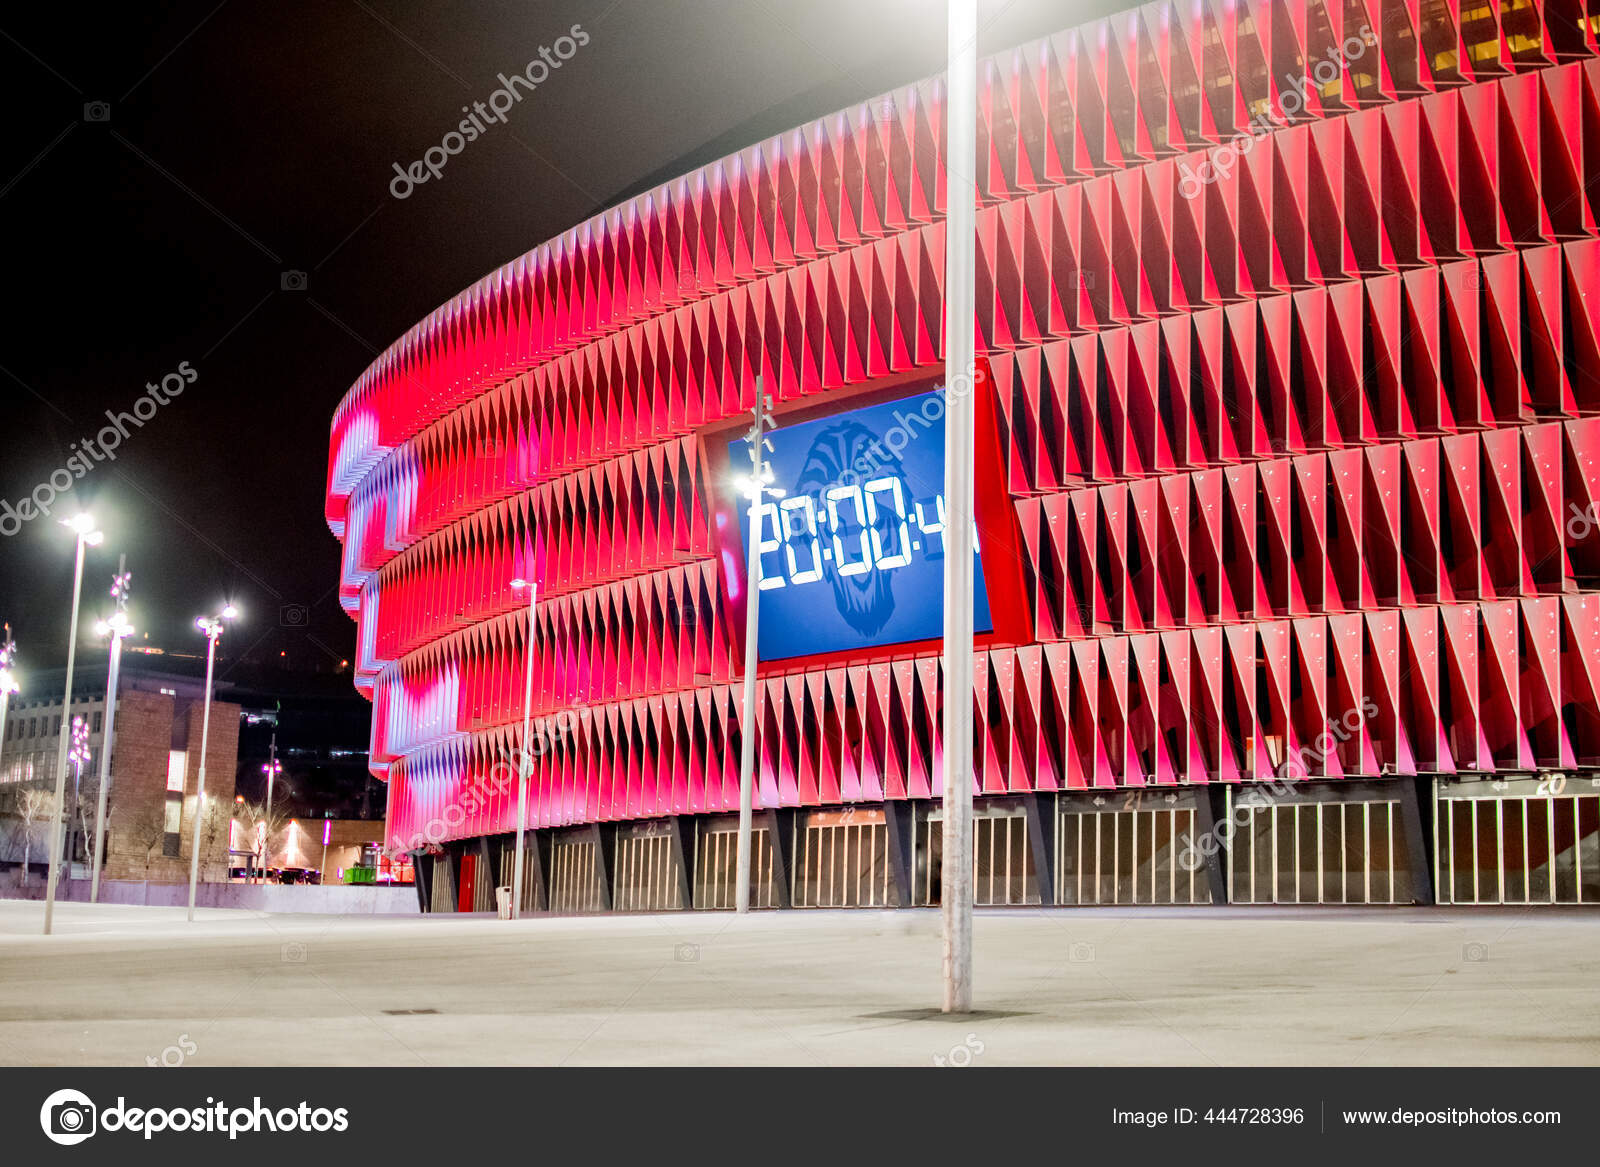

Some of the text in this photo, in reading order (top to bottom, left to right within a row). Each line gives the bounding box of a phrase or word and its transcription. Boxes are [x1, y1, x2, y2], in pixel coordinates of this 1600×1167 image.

[747, 476, 980, 591] 20:00:4
[1536, 773, 1566, 796] 20
[1124, 790, 1142, 811] 21
[839, 806, 856, 824] 22
